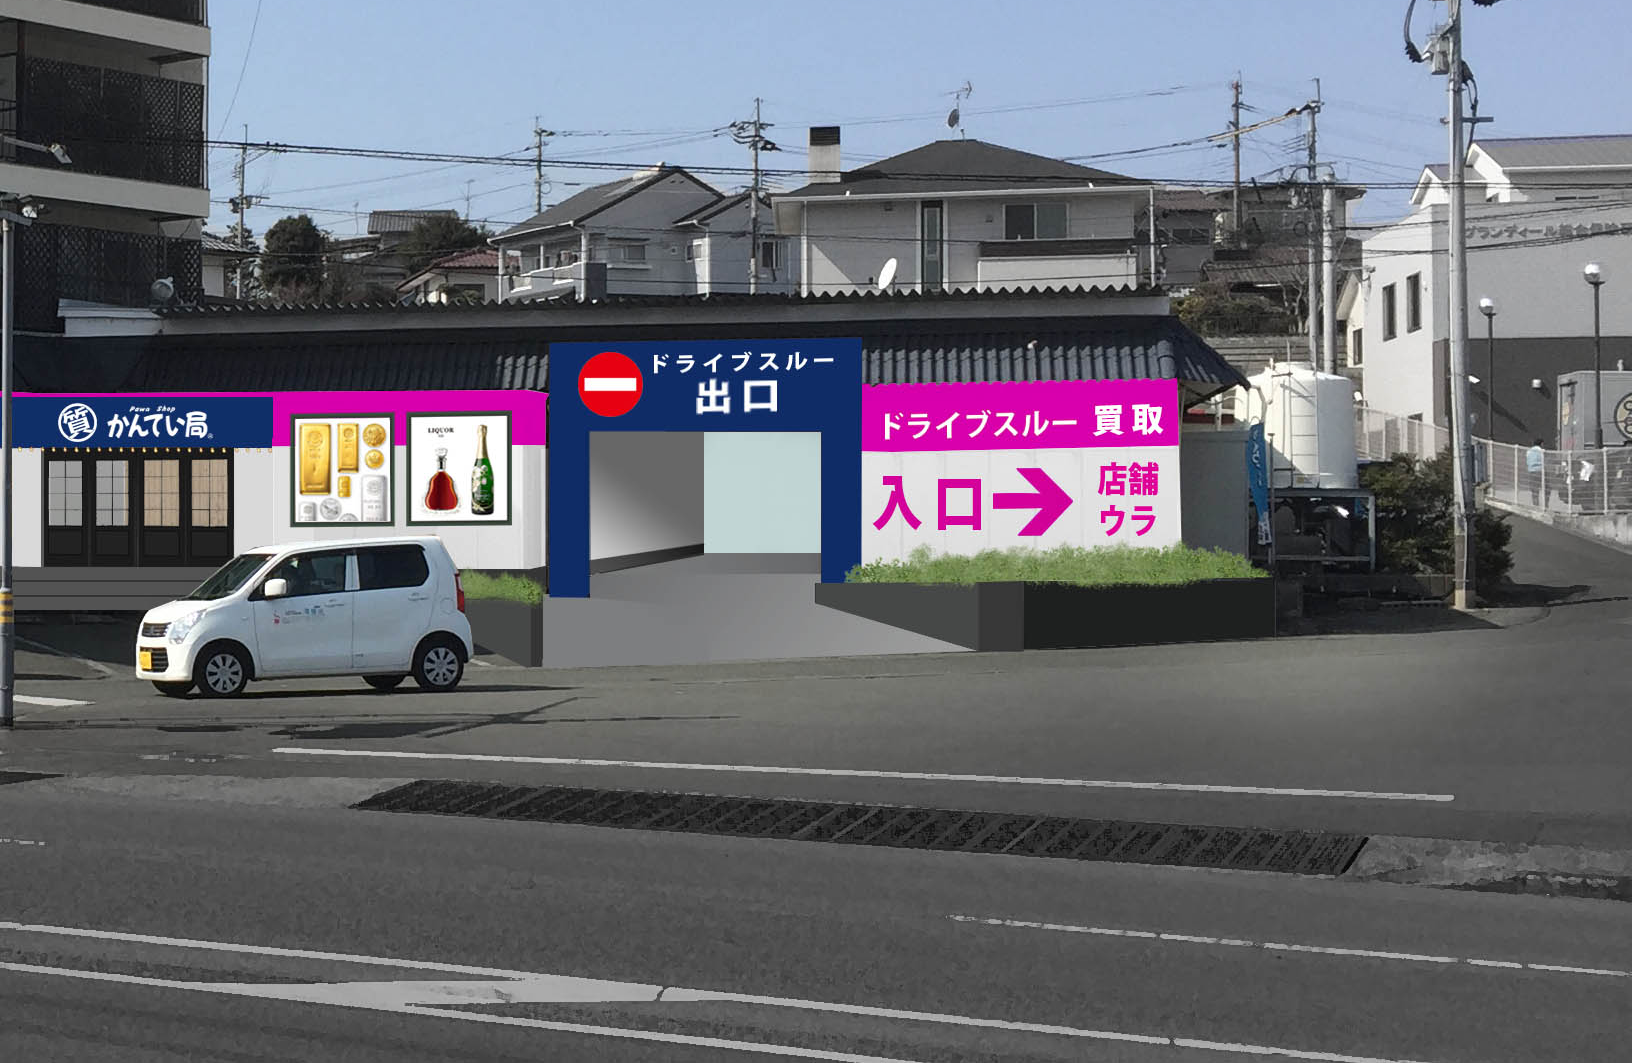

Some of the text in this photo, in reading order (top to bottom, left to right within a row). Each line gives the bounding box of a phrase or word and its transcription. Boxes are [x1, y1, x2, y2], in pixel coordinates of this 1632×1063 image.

[652, 351, 835, 374] ドライブスルー
[156, 405, 176, 413] Shop
[695, 378, 779, 415] 出口
[61, 406, 94, 440] 質
[106, 410, 209, 439] かんてい局
[882, 403, 1164, 440] ドライブスルー 買取
[1097, 461, 1160, 497] 店舗
[872, 475, 982, 531] 入口
[1100, 504, 1157, 537] ウラ
